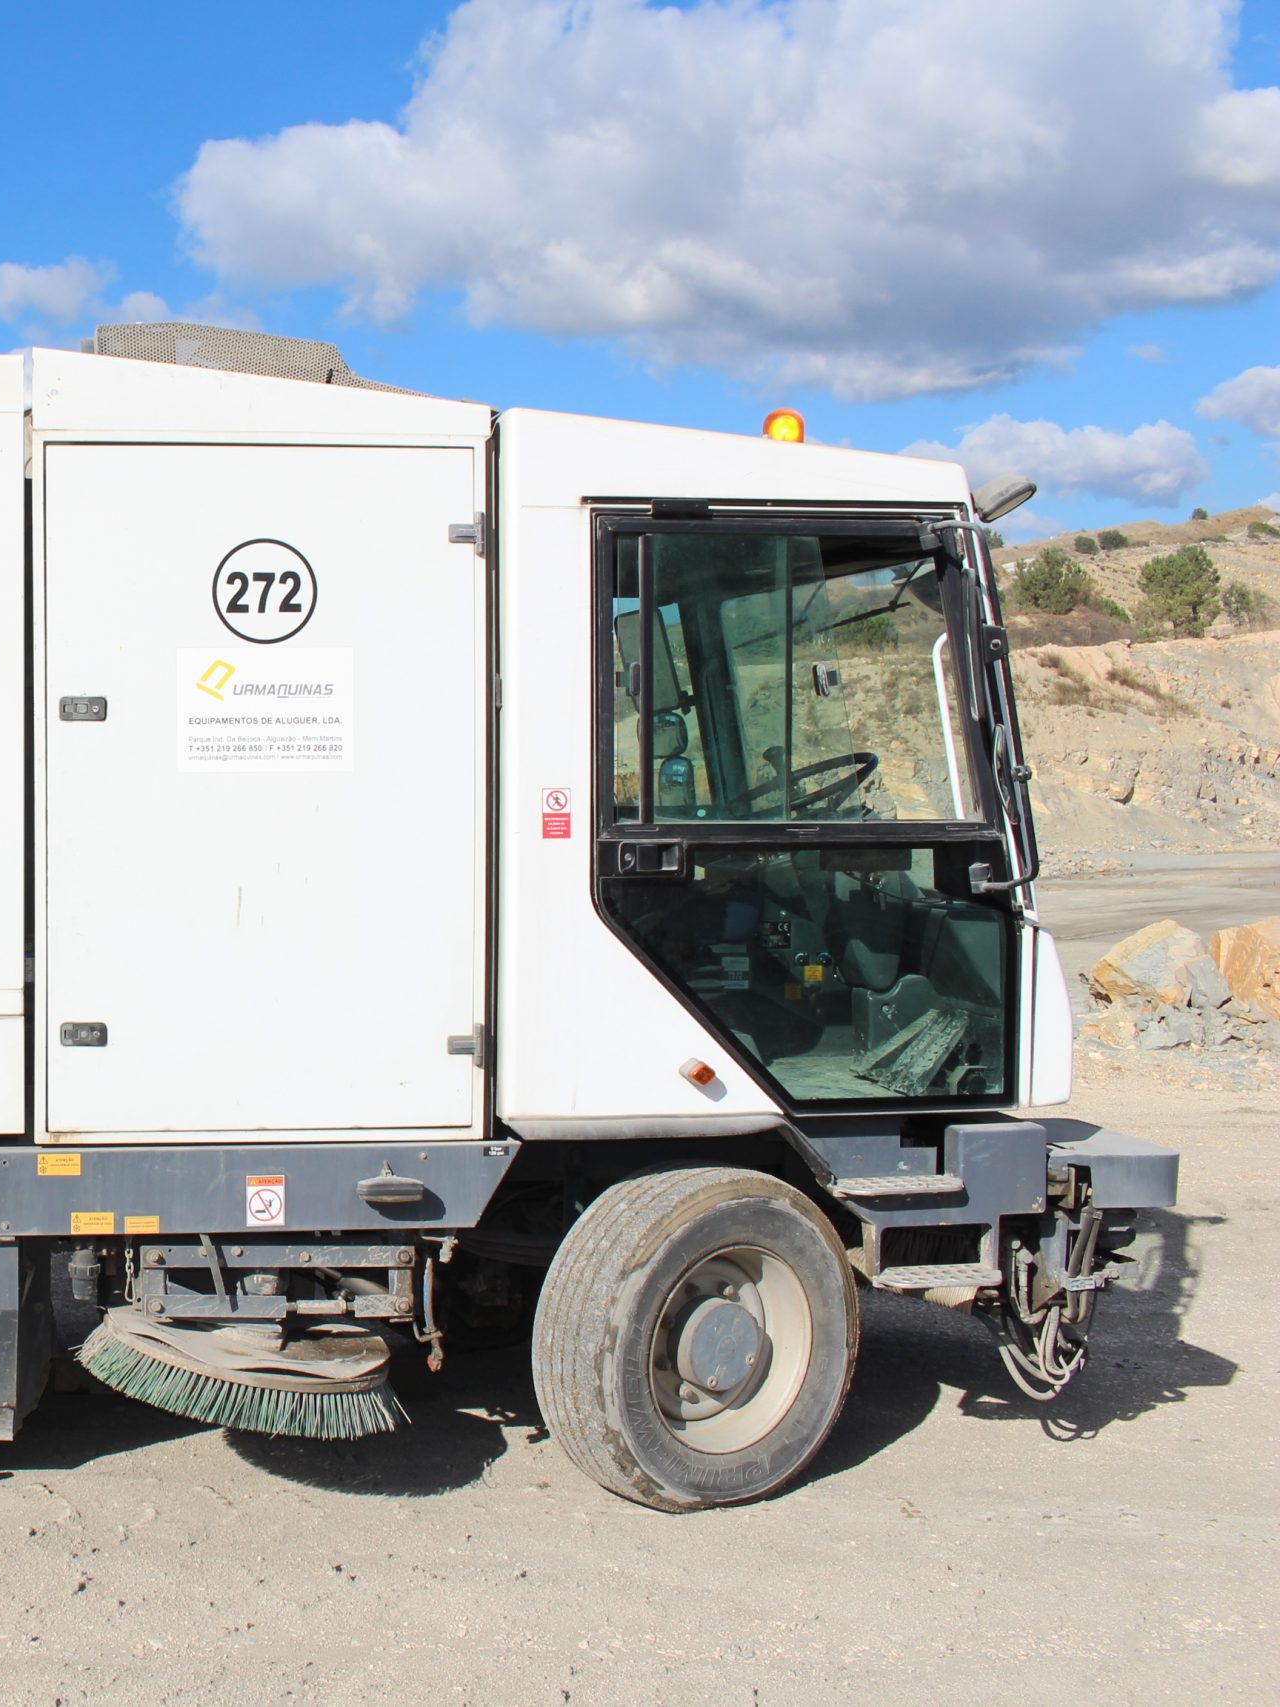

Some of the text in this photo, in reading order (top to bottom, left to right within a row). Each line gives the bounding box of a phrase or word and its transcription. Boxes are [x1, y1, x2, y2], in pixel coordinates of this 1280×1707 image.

[225, 570, 302, 614] 272
[188, 717, 259, 726] EQUIPAMENTOS
[260, 717, 273, 725] DE
[322, 716, 343, 725] LDA.
[319, 735, 343, 743] Martins
[269, 744, 275, 752] F
[277, 744, 295, 752] +351
[297, 744, 312, 752] 219
